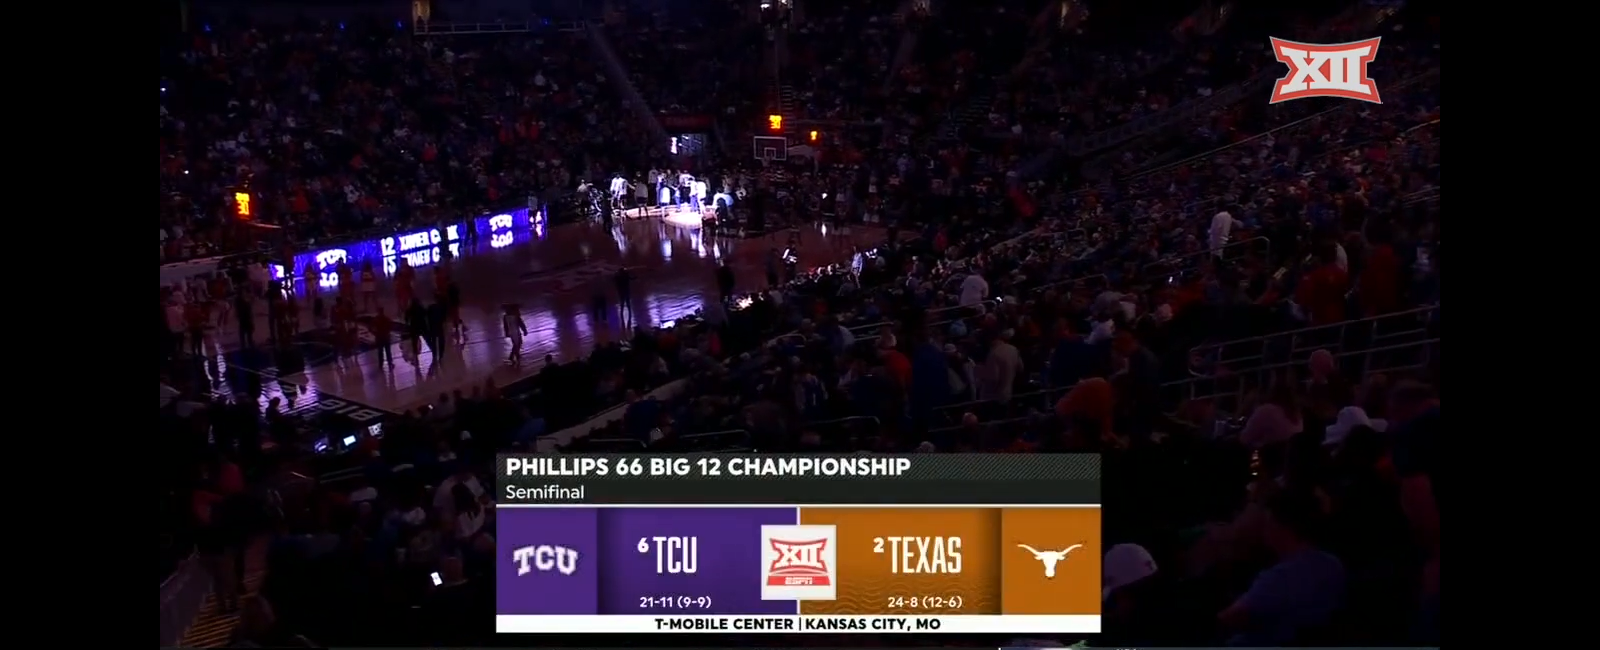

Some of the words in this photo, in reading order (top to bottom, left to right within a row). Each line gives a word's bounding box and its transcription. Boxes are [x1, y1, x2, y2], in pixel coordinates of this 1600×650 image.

[489, 214, 512, 232] TCU
[381, 236, 396, 256] 12
[399, 232, 430, 251] XAVIER
